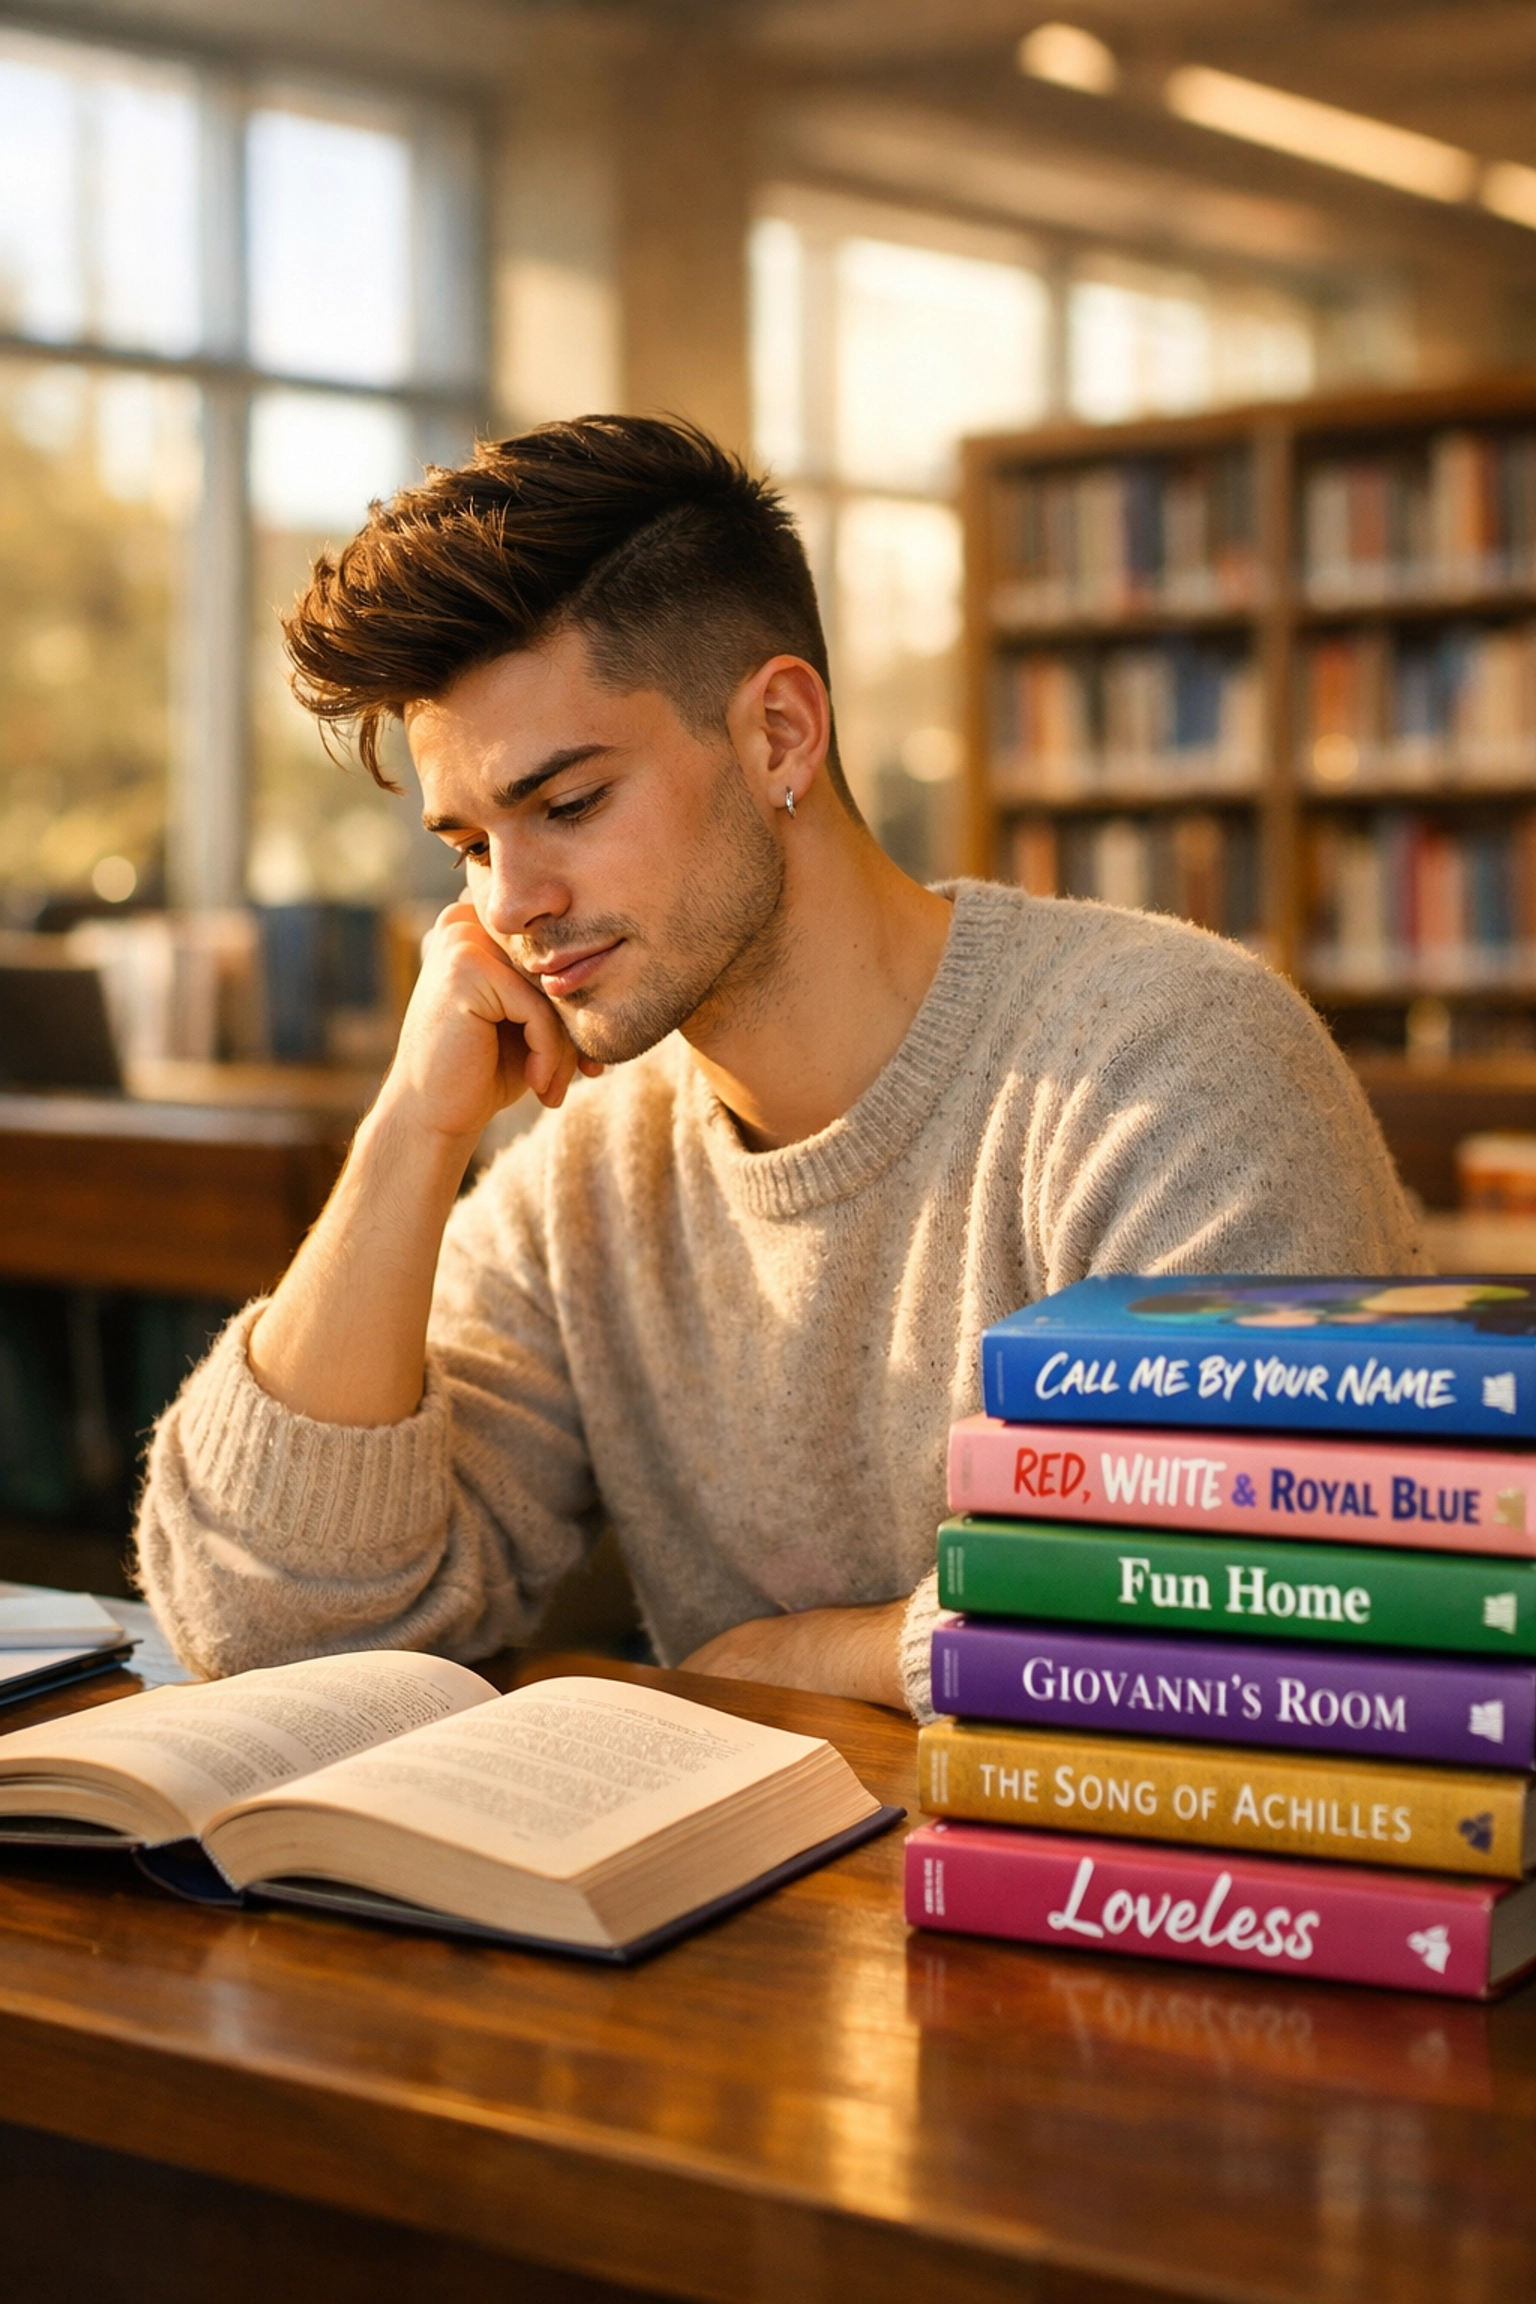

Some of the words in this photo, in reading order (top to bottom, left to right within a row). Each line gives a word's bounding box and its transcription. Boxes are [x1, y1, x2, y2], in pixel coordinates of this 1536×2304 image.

[1035, 1351, 1120, 1400] CALL
[1129, 1356, 1190, 1397] ME
[1198, 1354, 1246, 1400] BY
[1251, 1356, 1328, 1402] YOUR
[1336, 1358, 1456, 1408] NAME
[1014, 1447, 1091, 1504] RED,
[1100, 1453, 1226, 1511] WHITE
[1231, 1473, 1256, 1507] &
[1270, 1468, 1378, 1518] ROYAL
[1391, 1476, 1480, 1525] BLUE
[1118, 1556, 1212, 1611] Fun
[1225, 1565, 1370, 1624] Home
[1022, 1657, 1261, 1721] GIOVANNI'S
[1276, 1677, 1407, 1733] ROOM
[979, 1764, 1039, 1802] THE
[1054, 1765, 1157, 1816] SONG
[1174, 1783, 1217, 1818] OF
[1233, 1785, 1411, 1843] ACHILLES
[1048, 1857, 1321, 1961] Loveless
